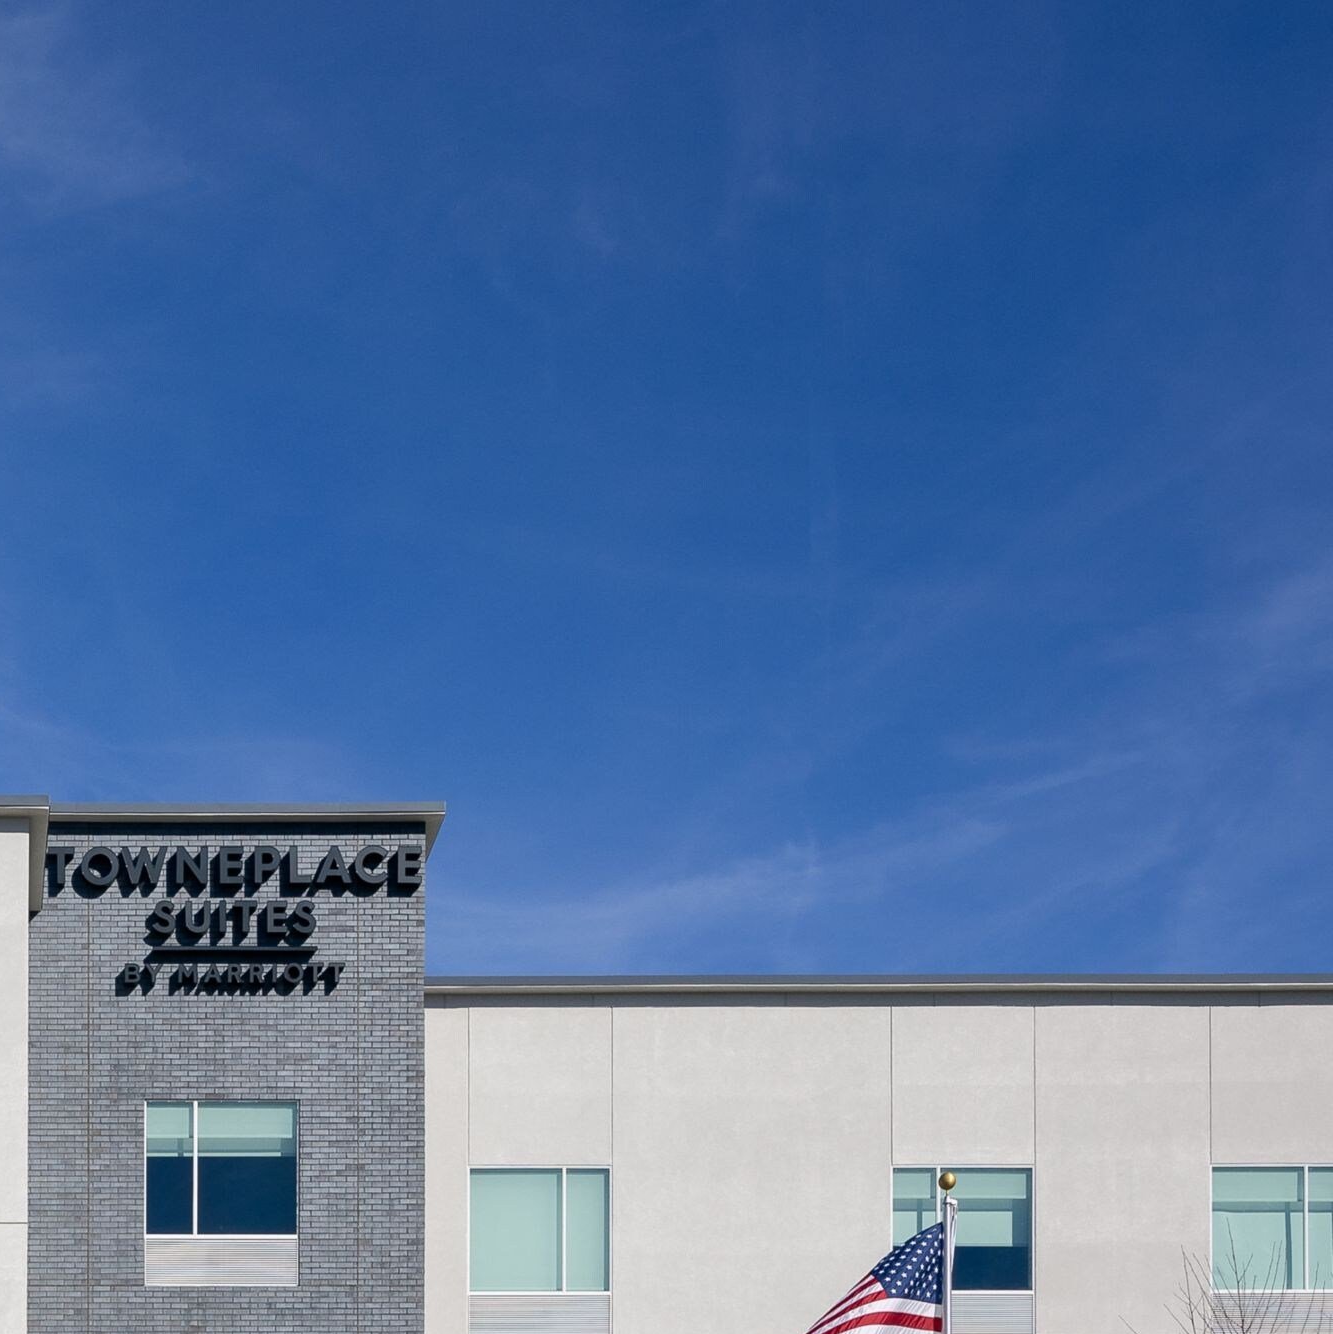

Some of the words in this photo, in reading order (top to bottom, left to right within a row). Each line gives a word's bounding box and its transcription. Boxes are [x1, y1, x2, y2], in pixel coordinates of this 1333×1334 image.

[47, 845, 423, 886] TOWNEPLACE
[152, 900, 317, 934] SUITES
[124, 962, 160, 984] BY
[178, 962, 346, 984] MARRIOTT
